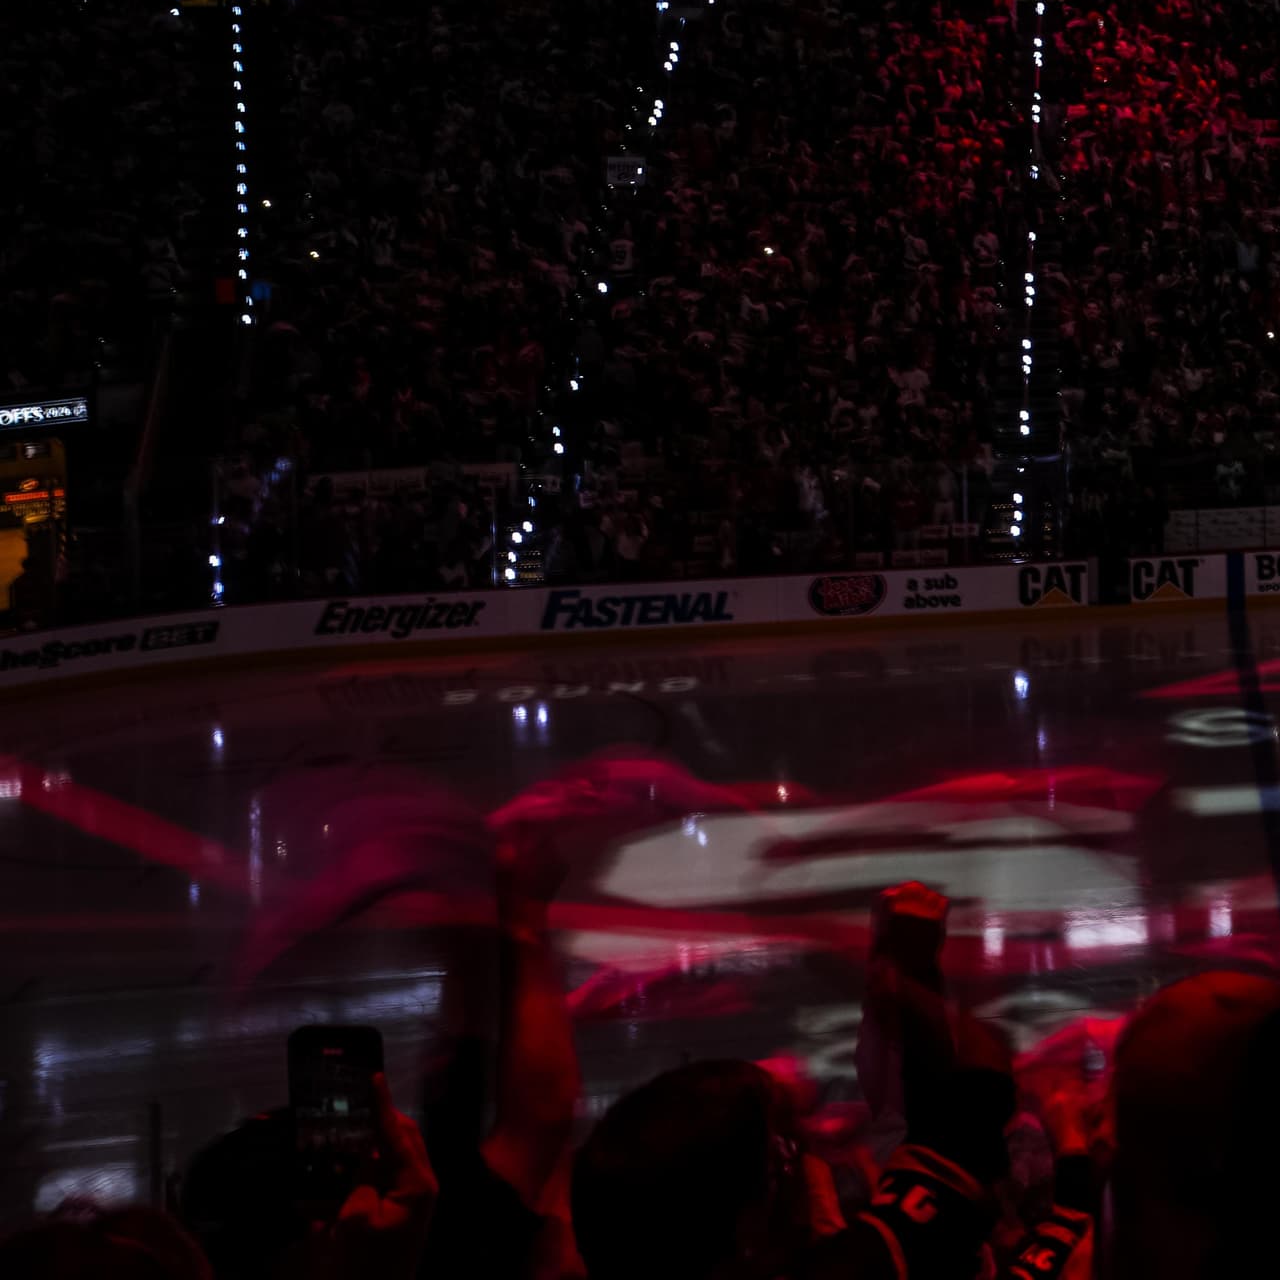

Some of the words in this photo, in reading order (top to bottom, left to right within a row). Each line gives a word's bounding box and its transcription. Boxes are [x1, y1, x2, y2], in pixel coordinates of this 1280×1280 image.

[907, 578, 918, 591] a
[924, 572, 958, 590] sub
[1020, 565, 1086, 606] CAT
[1133, 560, 1198, 600] CAT
[315, 598, 485, 638] Energizer
[542, 590, 734, 628] FASTENAL
[904, 594, 961, 609] above
